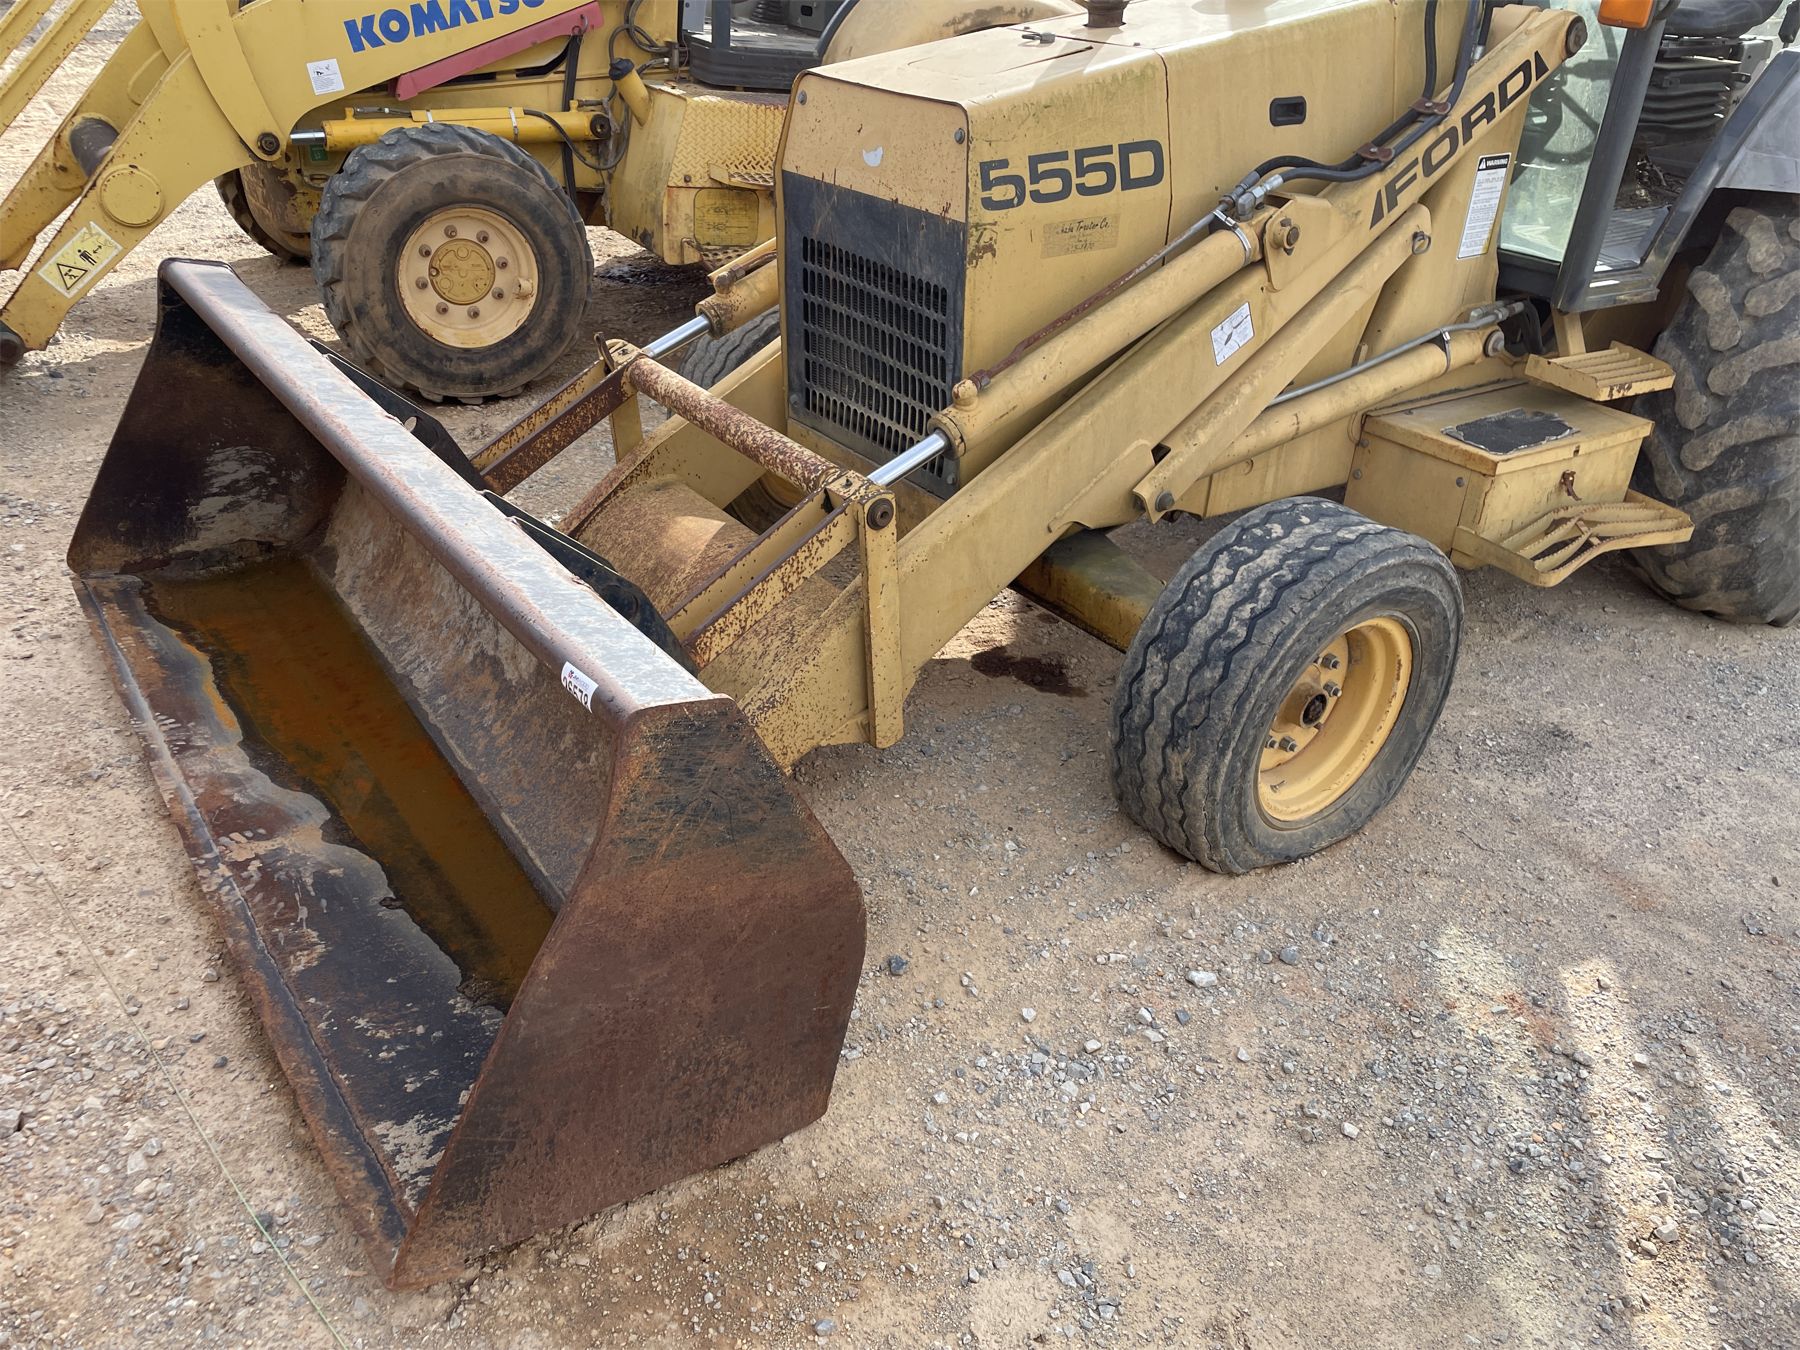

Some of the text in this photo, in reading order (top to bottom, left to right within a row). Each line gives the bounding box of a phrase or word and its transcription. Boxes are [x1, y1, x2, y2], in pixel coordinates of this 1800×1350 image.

[344, 0, 545, 53] KOMATS
[1385, 59, 1532, 214] FORD
[980, 139, 1165, 211] 555D
